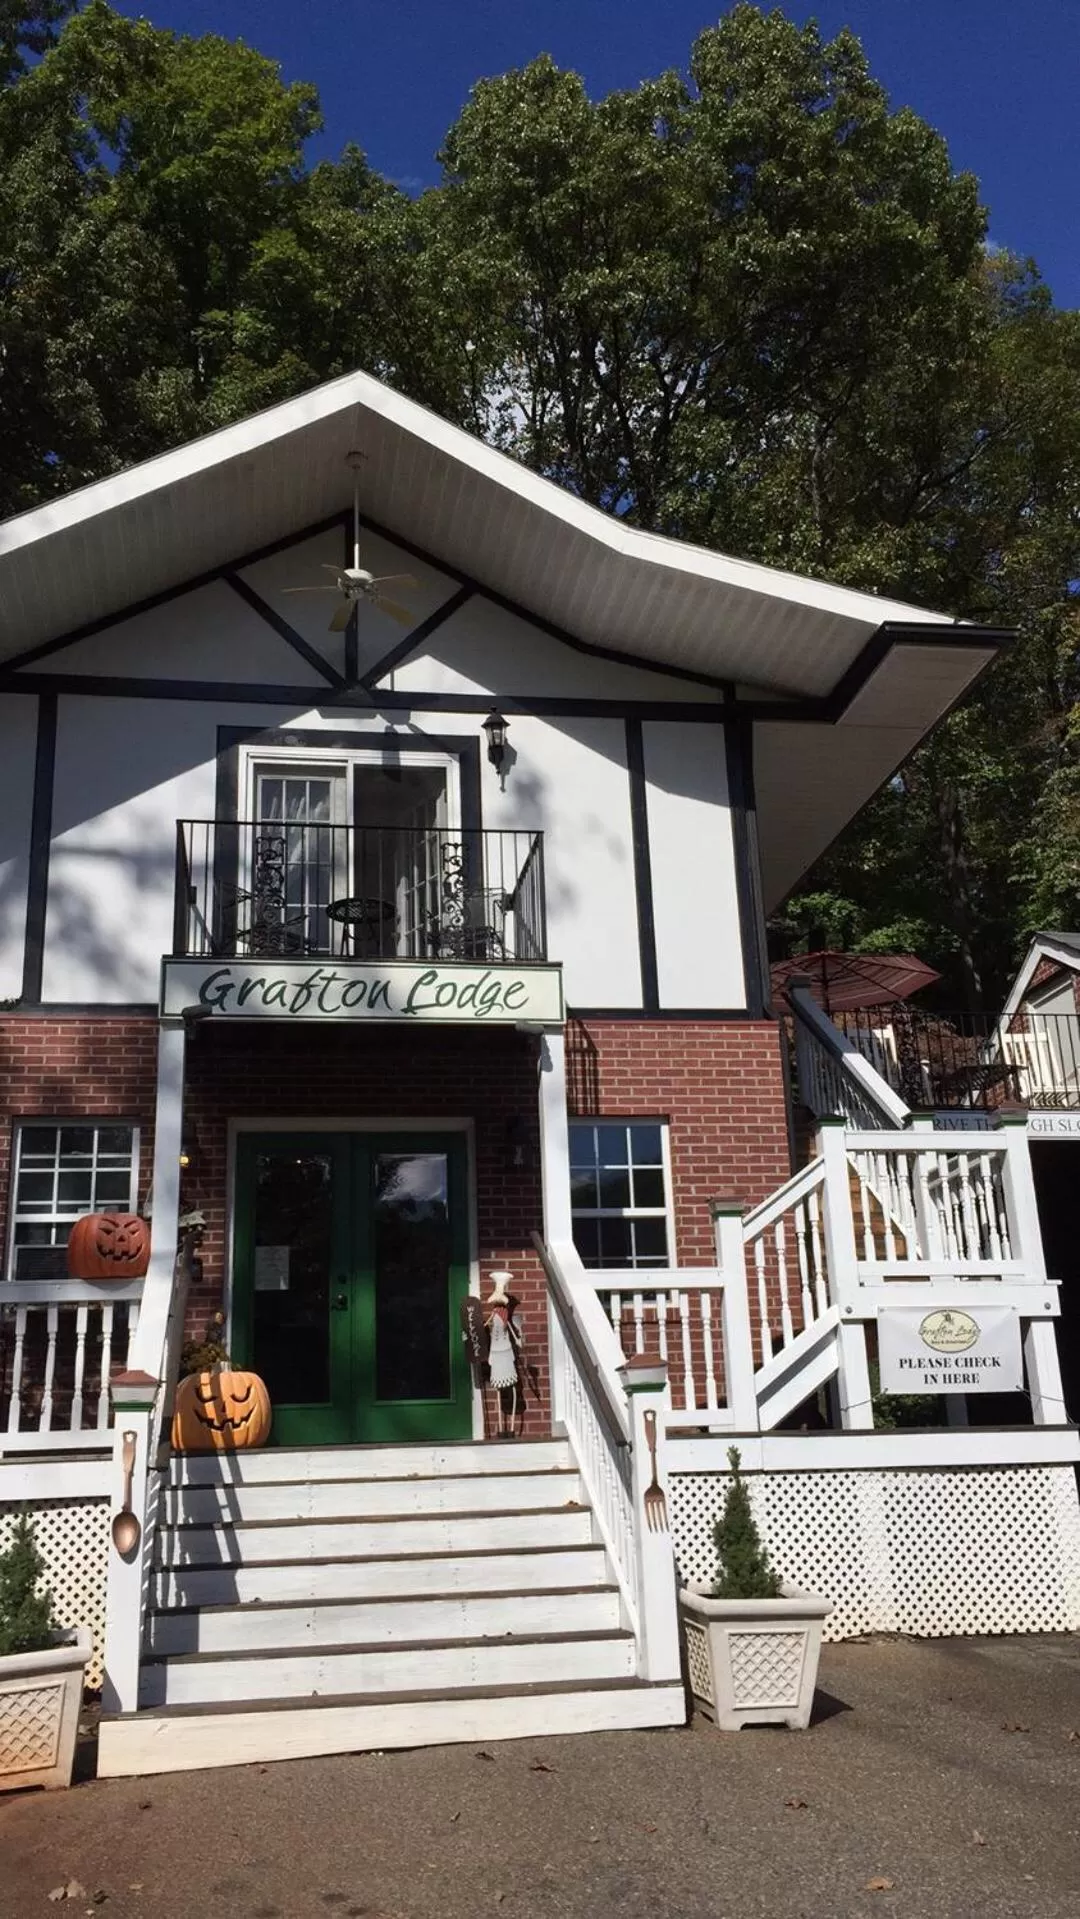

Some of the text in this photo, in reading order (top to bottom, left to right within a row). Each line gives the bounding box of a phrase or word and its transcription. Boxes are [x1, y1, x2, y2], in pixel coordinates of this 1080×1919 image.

[201, 968, 529, 1017] Grafton Lodge
[899, 1356, 1001, 1369] PLEASE CHECK
[924, 1372, 980, 1384] IN HERE
